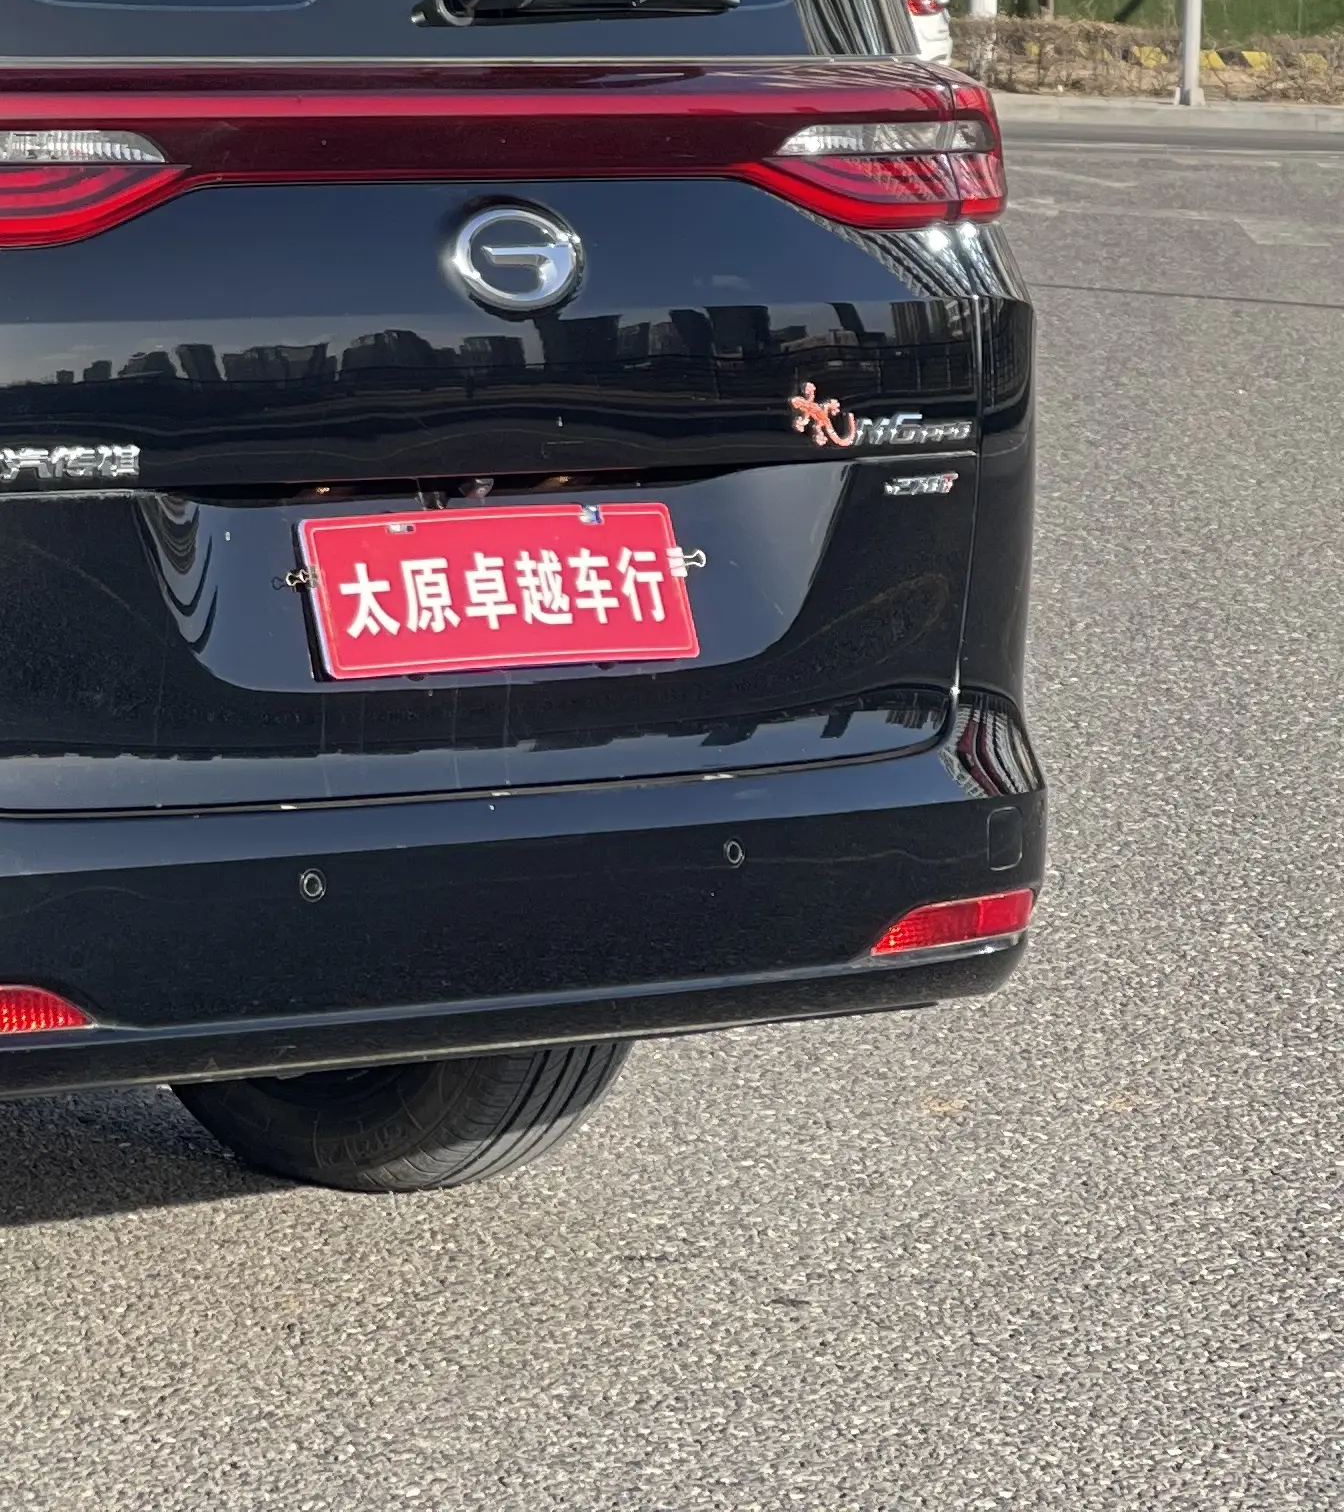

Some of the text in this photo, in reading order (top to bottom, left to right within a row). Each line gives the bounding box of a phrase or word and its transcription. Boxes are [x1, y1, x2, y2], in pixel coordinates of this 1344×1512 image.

[339, 546, 665, 640] 太原卓越车行
